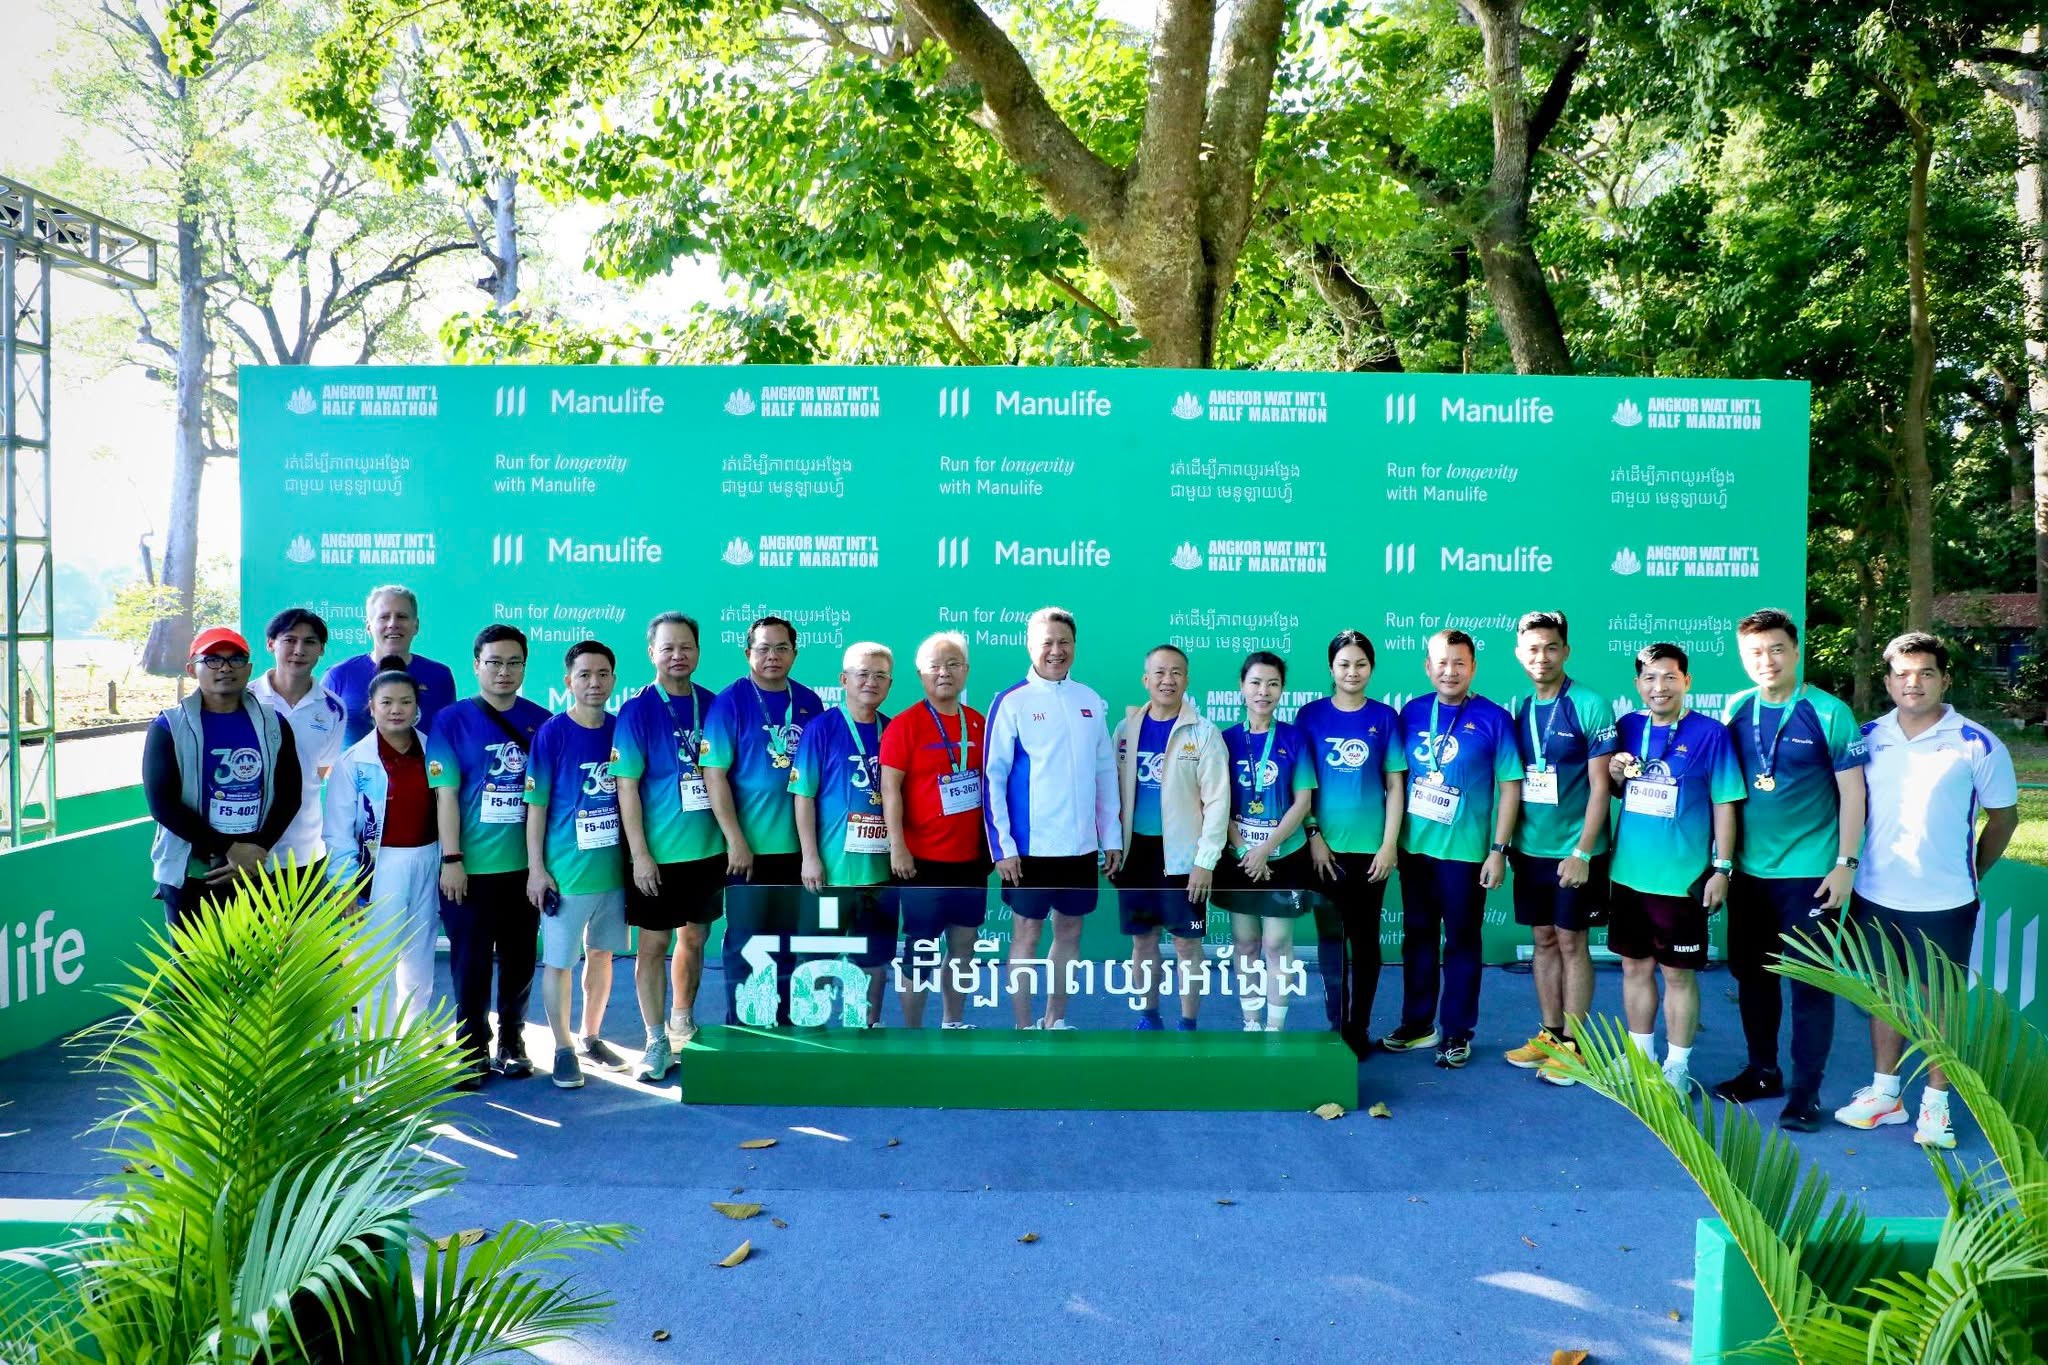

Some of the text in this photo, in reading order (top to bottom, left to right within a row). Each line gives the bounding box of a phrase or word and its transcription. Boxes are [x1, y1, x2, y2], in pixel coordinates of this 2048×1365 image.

[323, 385, 438, 401] ANGKOR WAT INT'L
[550, 387, 666, 415] Manulife
[761, 386, 880, 402] ANGKOR WAT INT'L
[1208, 390, 1327, 407] ANGKOR WAT INT'L
[323, 400, 439, 417] HALF MARATHON
[761, 401, 881, 418] HALF MARATHON
[995, 388, 1112, 417] Manulife
[1441, 396, 1555, 424] Manulife
[1648, 397, 1761, 414] ANGKOR WAT INT'L
[1209, 406, 1328, 423] HALF MARATHON
[1648, 413, 1762, 431] HALF MARATHON
[495, 452, 629, 474] Run for longevity
[940, 456, 1075, 476] Run for longevity
[1386, 462, 1518, 482] Run for longevity
[492, 477, 597, 496] with Manulife
[939, 479, 1043, 496] with Manulife
[1386, 486, 1488, 502] with Manulife
[321, 532, 436, 549] ANGKOR WAT INT'L
[547, 533, 663, 564] Manulife
[760, 535, 879, 552] ANGKOR WAT INT'L
[1208, 539, 1327, 557] ANGKOR WAT INT'L
[322, 548, 437, 566] HALF MARATHON
[759, 551, 879, 568] HALF MARATHON
[995, 539, 1112, 568] Manulife
[1440, 545, 1553, 573] Manulife
[1646, 545, 1760, 562] ANGKOR WAT INT'L
[1208, 556, 1327, 573] HALF MARATHON
[1647, 561, 1760, 577] HALF MARATHON
[492, 602, 626, 624] Run for longevity
[938, 607, 968, 622] Run
[973, 607, 995, 622] for
[1384, 611, 1517, 632] Run for longevity
[531, 626, 594, 642] Manulife
[976, 630, 1027, 646] Manuli
[1384, 634, 1415, 651] with
[1206, 706, 1241, 722] HALF
[949, 781, 979, 798] F5-3621
[1630, 786, 1668, 800] F5-4006
[1414, 789, 1450, 808] F5-4009
[856, 825, 888, 839] 11905
